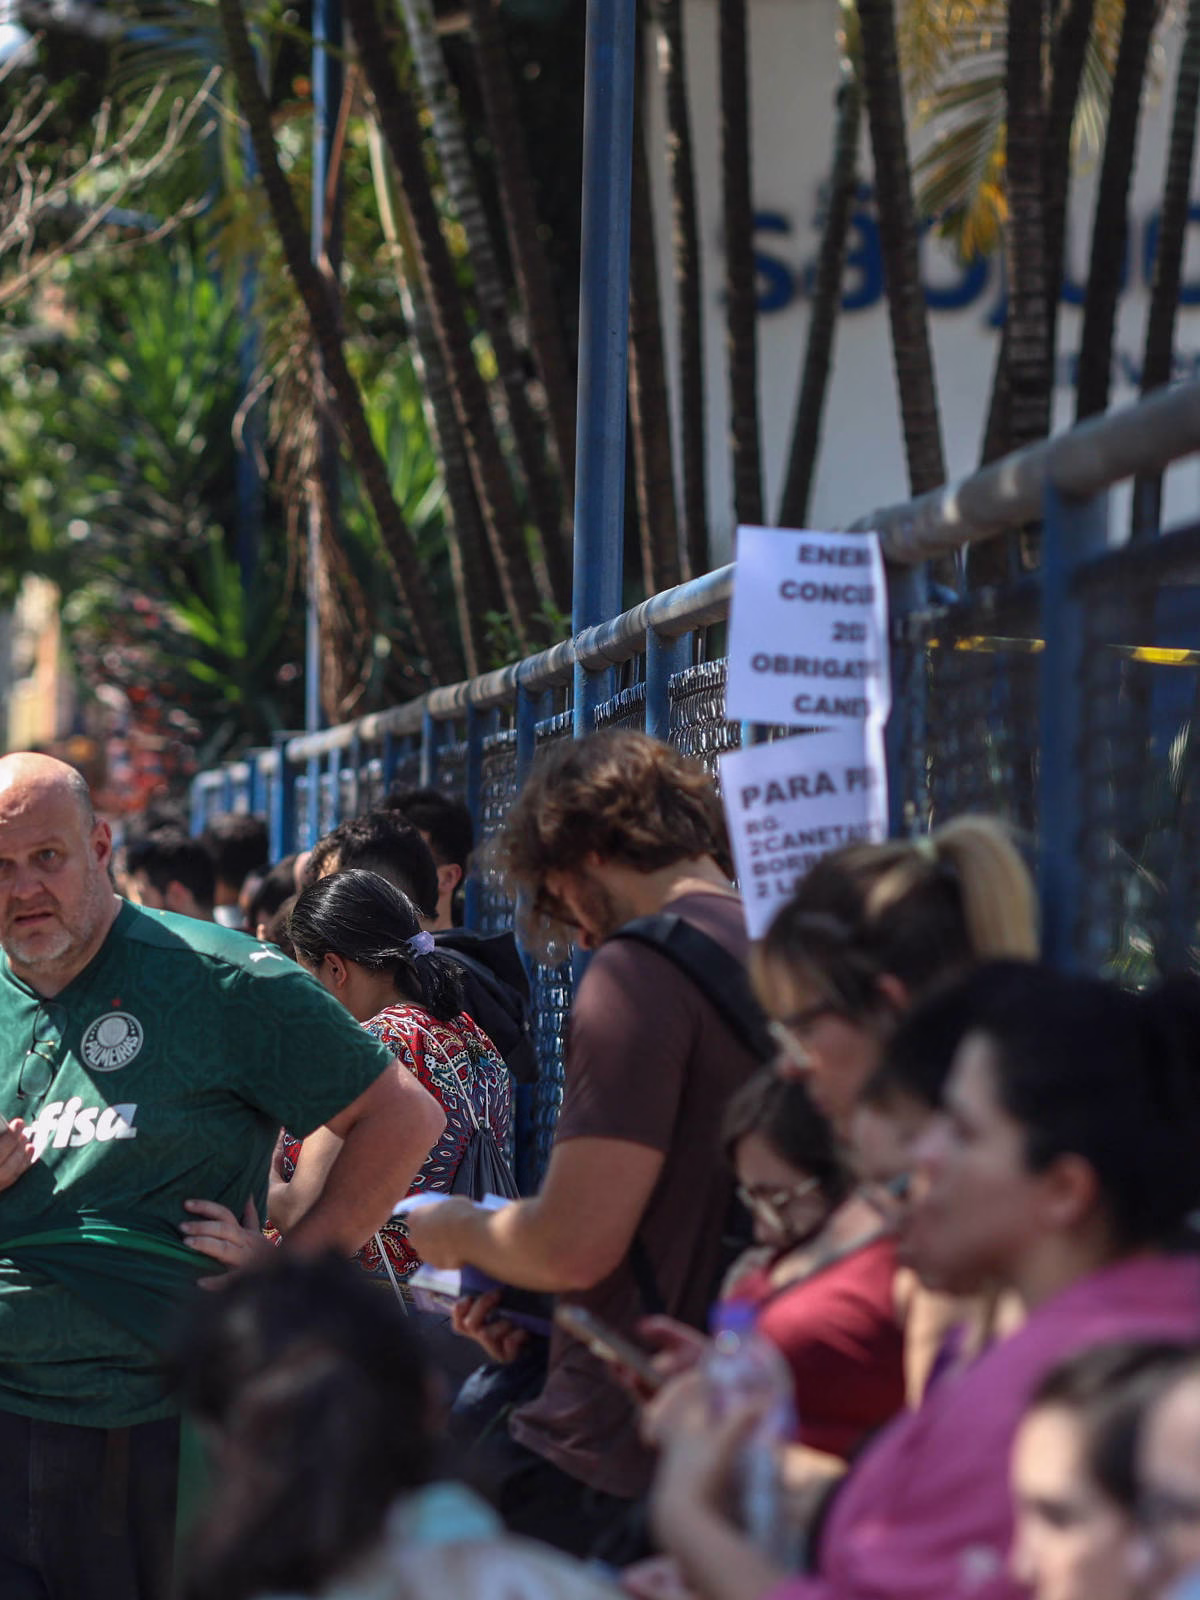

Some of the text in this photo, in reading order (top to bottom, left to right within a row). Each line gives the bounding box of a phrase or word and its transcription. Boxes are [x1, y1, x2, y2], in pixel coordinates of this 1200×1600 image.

[751, 653, 882, 680] OBRIGAT
[742, 771, 835, 810] PARA
[86, 1036, 139, 1067] PALMEIRAS
[22, 1096, 138, 1163] fisa
